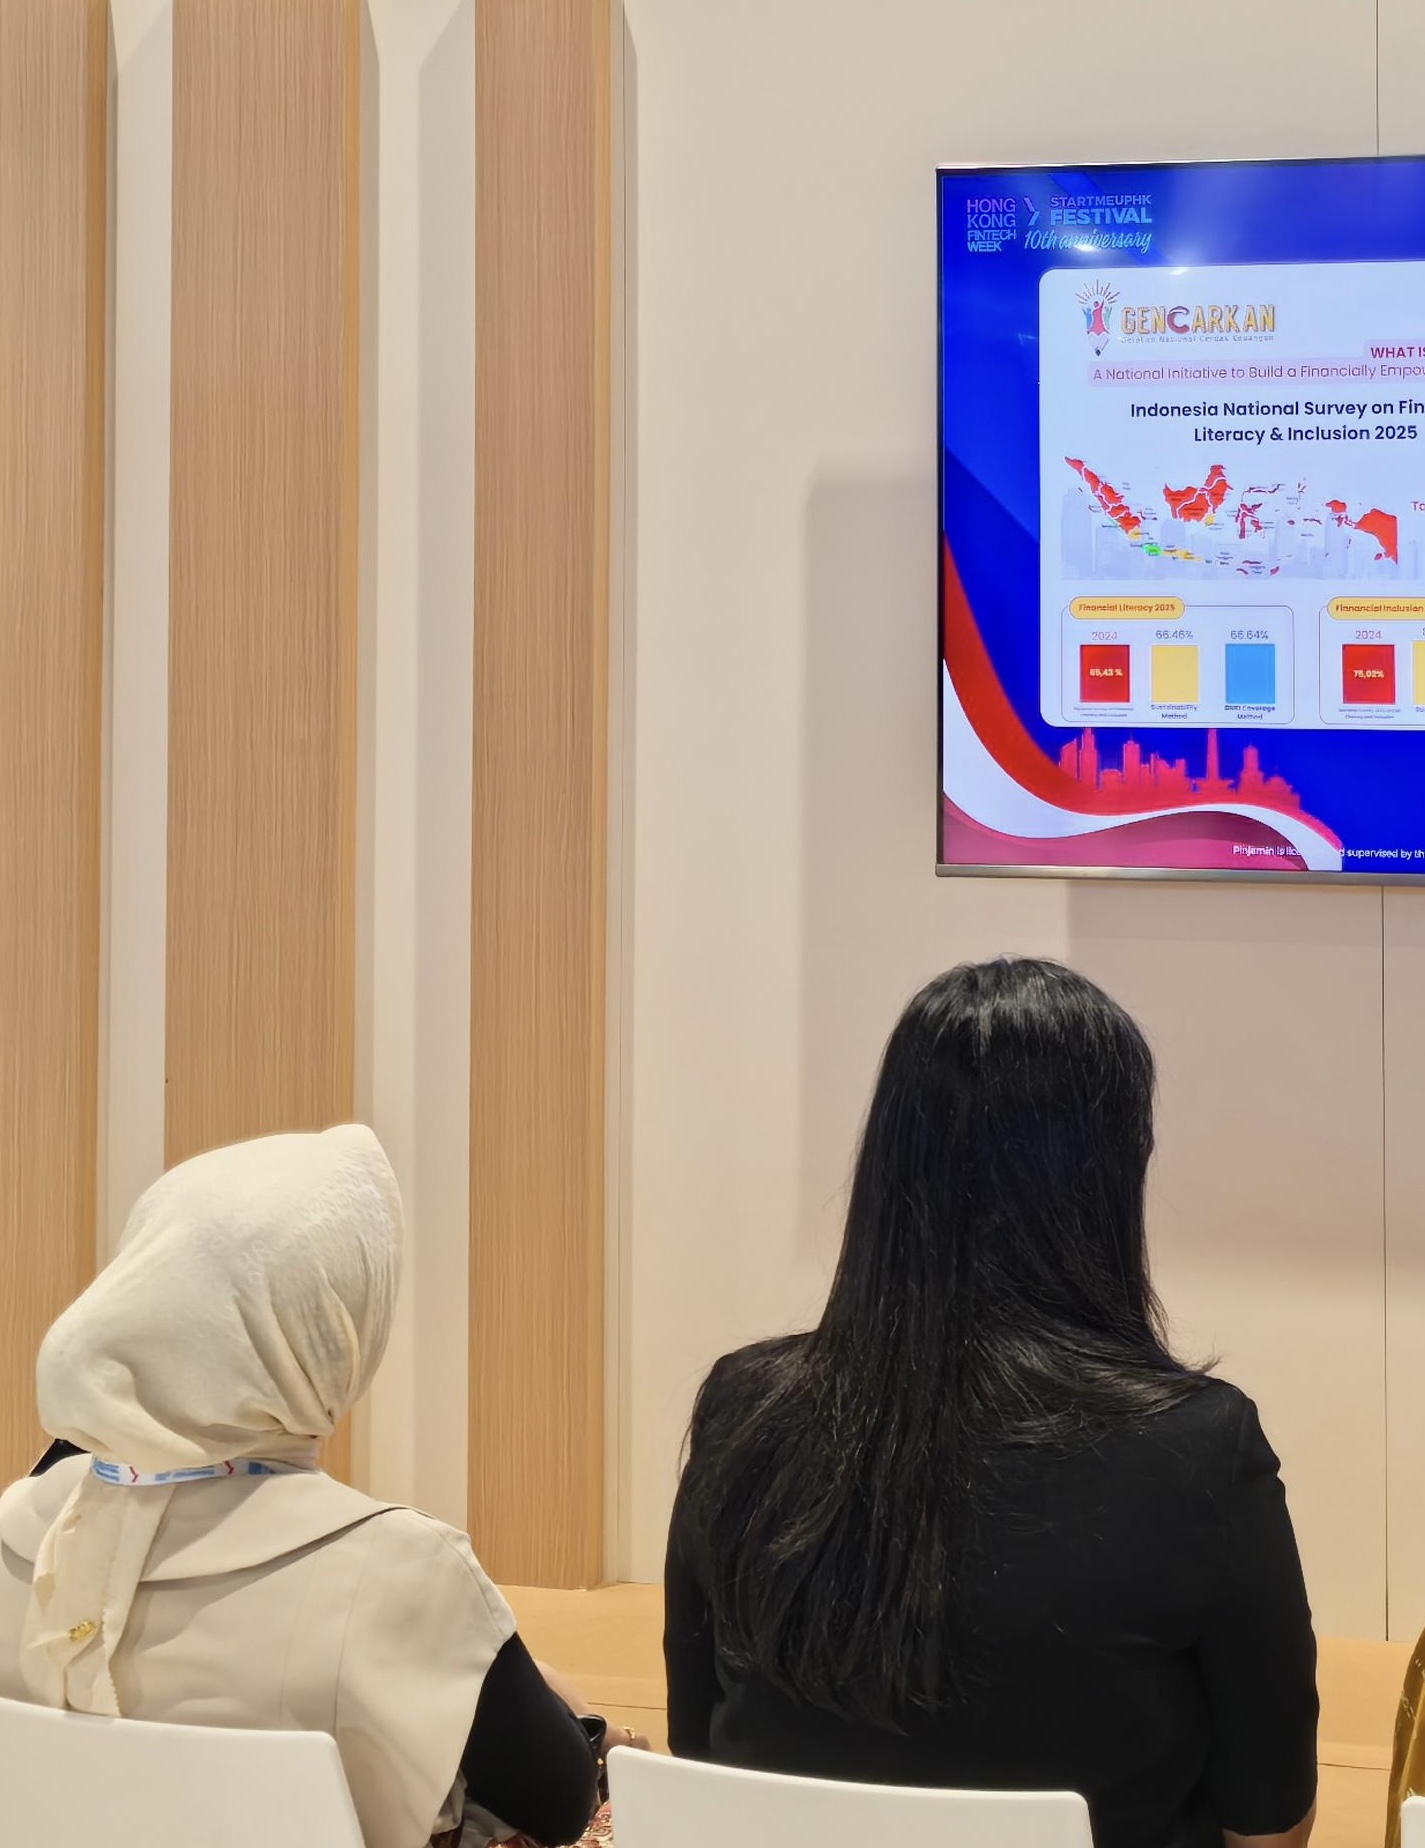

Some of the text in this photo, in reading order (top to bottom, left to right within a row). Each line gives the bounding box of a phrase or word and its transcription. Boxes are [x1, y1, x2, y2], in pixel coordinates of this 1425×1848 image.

[967, 199, 1016, 213] HONG
[1050, 195, 1152, 209] STARTMEUPHK
[967, 214, 1016, 228] KONG
[1050, 208, 1152, 226] FESTIVAL
[967, 229, 1016, 241] FINTECH
[1024, 228, 1152, 254] 10th anniversary
[967, 241, 1002, 252] WEEK
[1121, 304, 1275, 334] GENCARKAN
[1371, 346, 1415, 359] WHAT
[1093, 369, 1103, 380] A
[1105, 367, 1164, 380] National
[1168, 365, 1227, 380] Initiative
[1231, 367, 1246, 378] to
[1249, 365, 1283, 378] Build
[1287, 368, 1297, 378] a
[1300, 363, 1376, 380] Financially
[1131, 402, 1218, 417] Indonesia
[1223, 401, 1299, 417] National
[1304, 401, 1367, 420] Survey
[1371, 404, 1394, 415] on
[1194, 425, 1418, 445] Literacy & Inclusion 2025
[1091, 631, 1118, 640] 2024
[1355, 630, 1382, 640] 2024
[1233, 845, 1275, 857] Pinjamin
[1347, 848, 1398, 860] supervised
[1400, 849, 1412, 861] by
